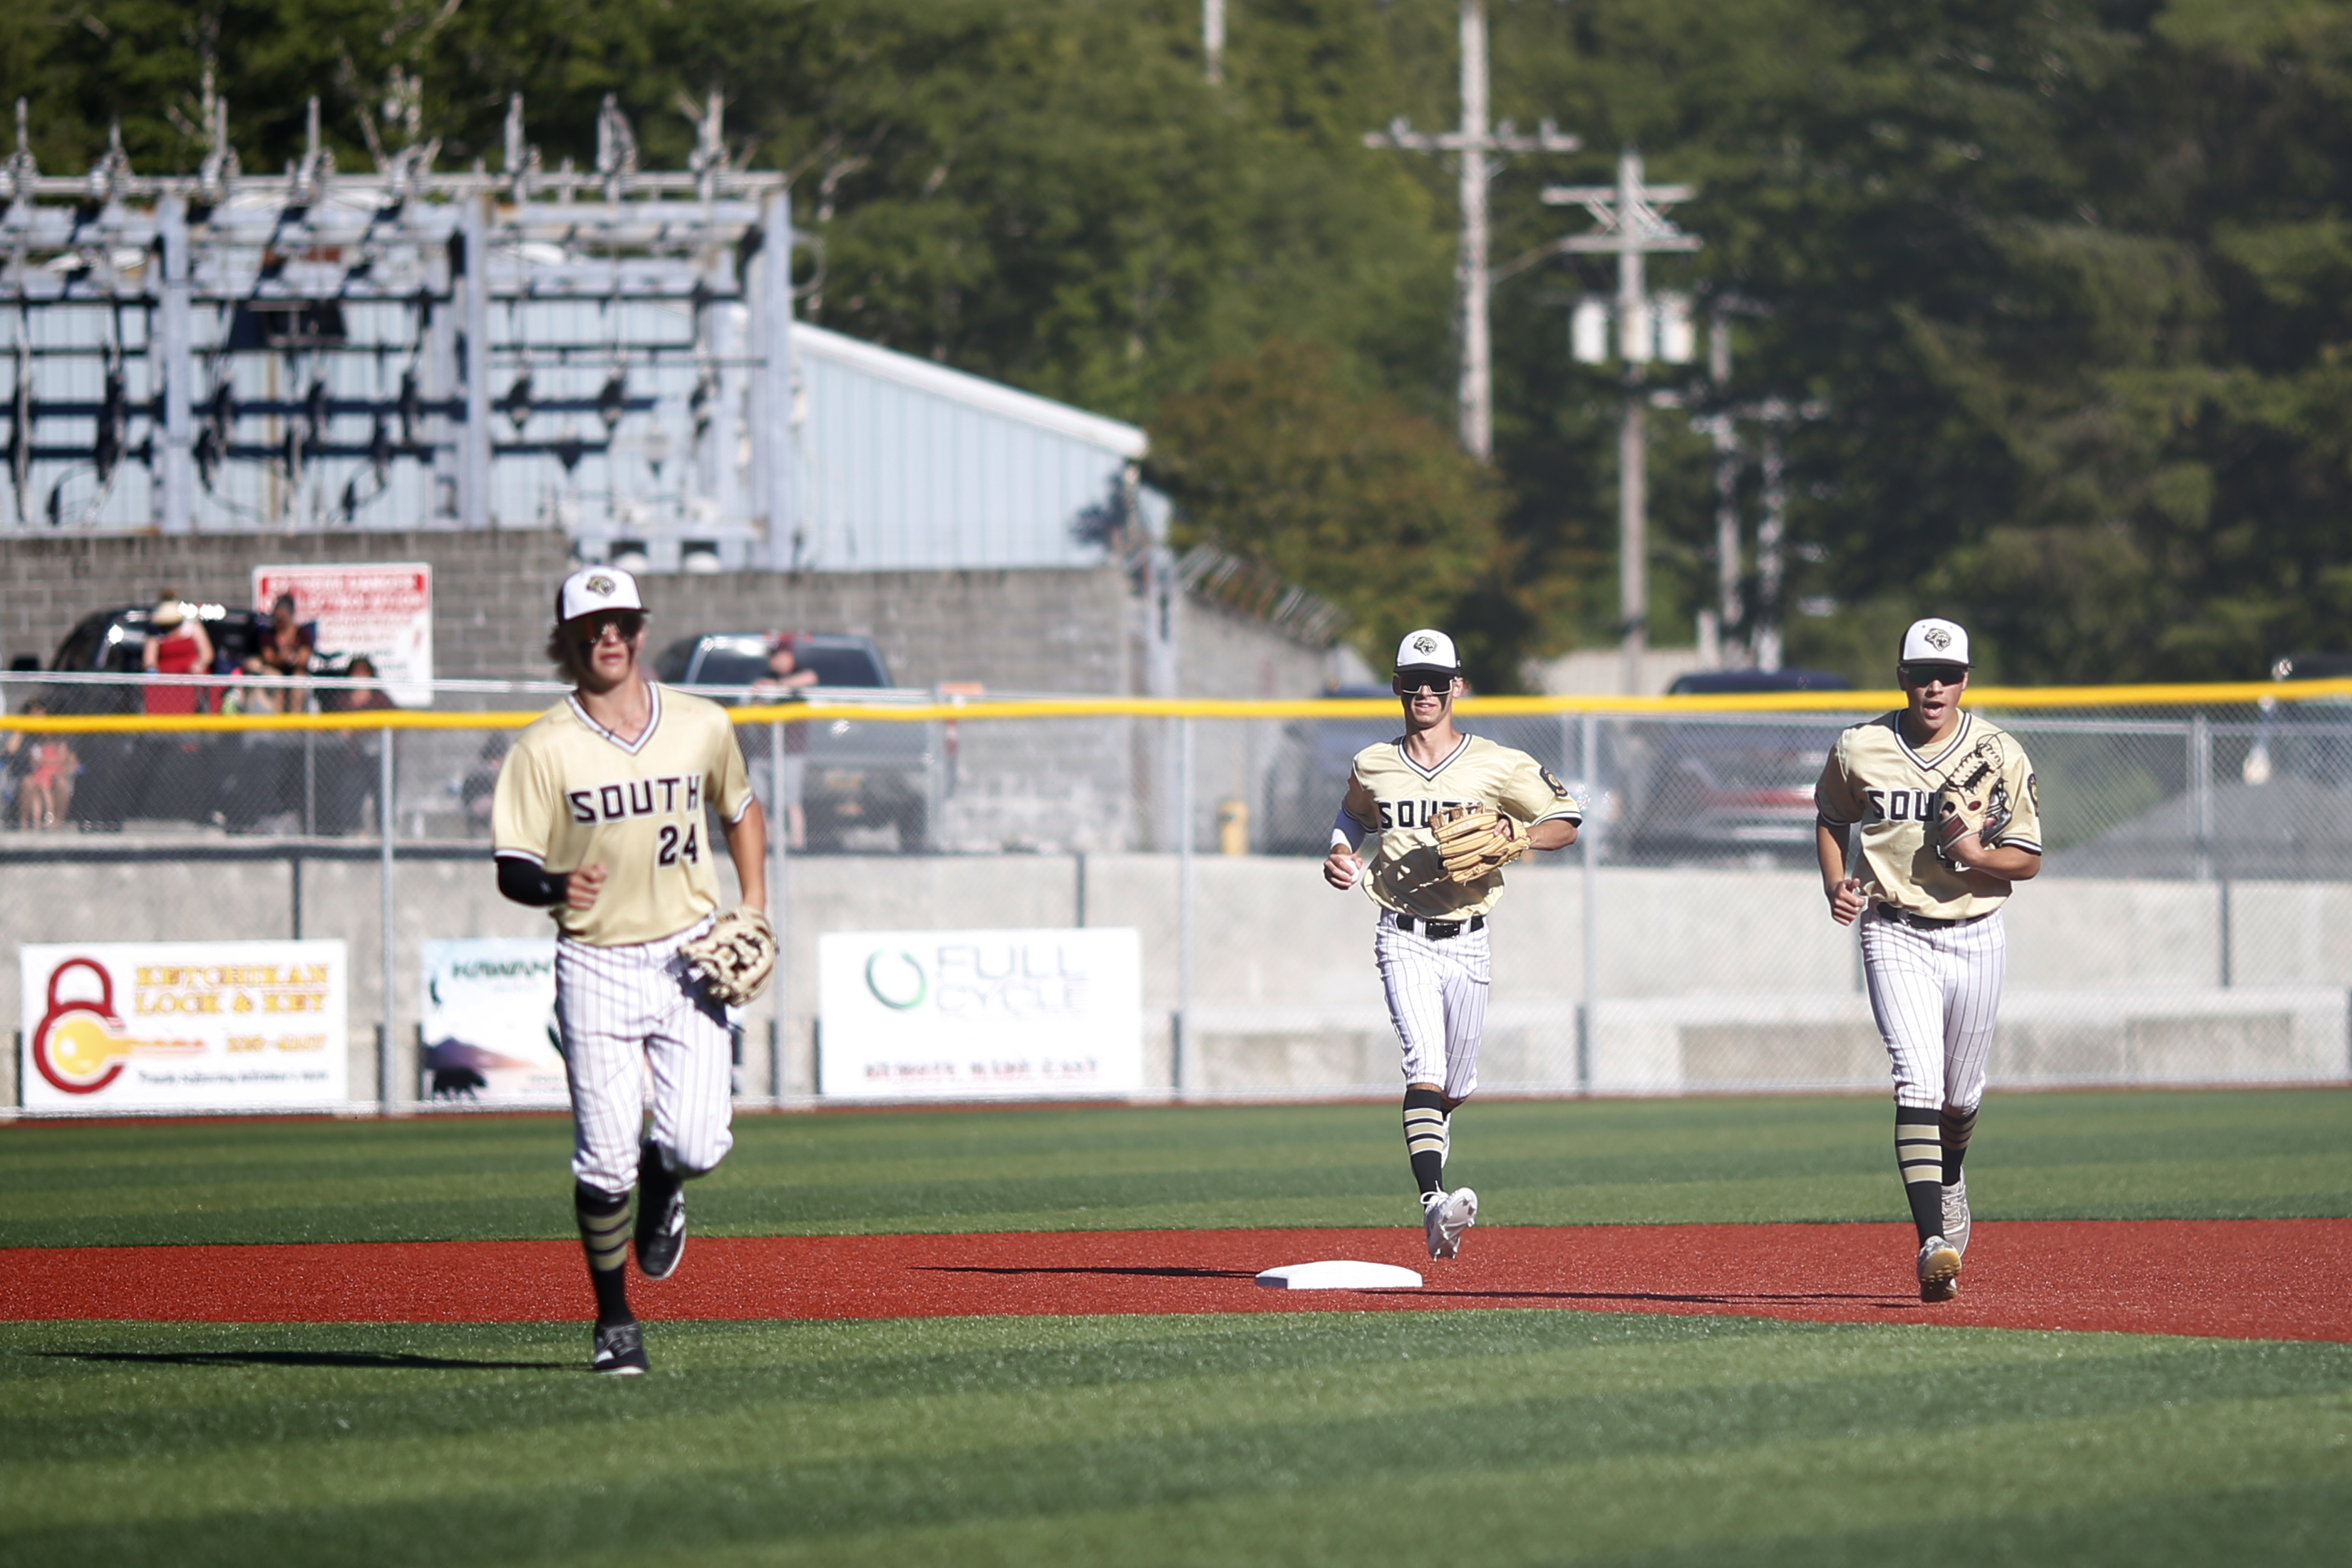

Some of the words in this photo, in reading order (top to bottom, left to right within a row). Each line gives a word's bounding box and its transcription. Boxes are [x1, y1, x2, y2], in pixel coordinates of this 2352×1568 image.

[569, 774, 701, 825] SOUTH
[1377, 799, 1482, 829] SOUT
[1864, 788, 1944, 822] SOU
[657, 821, 699, 868] 24
[136, 966, 328, 986] KETCHIKAN
[937, 945, 1086, 979] FULL
[136, 993, 221, 1013] LOCK
[232, 991, 253, 1012] &
[264, 992, 326, 1013] KEY
[937, 984, 1088, 1011] CYCLE
